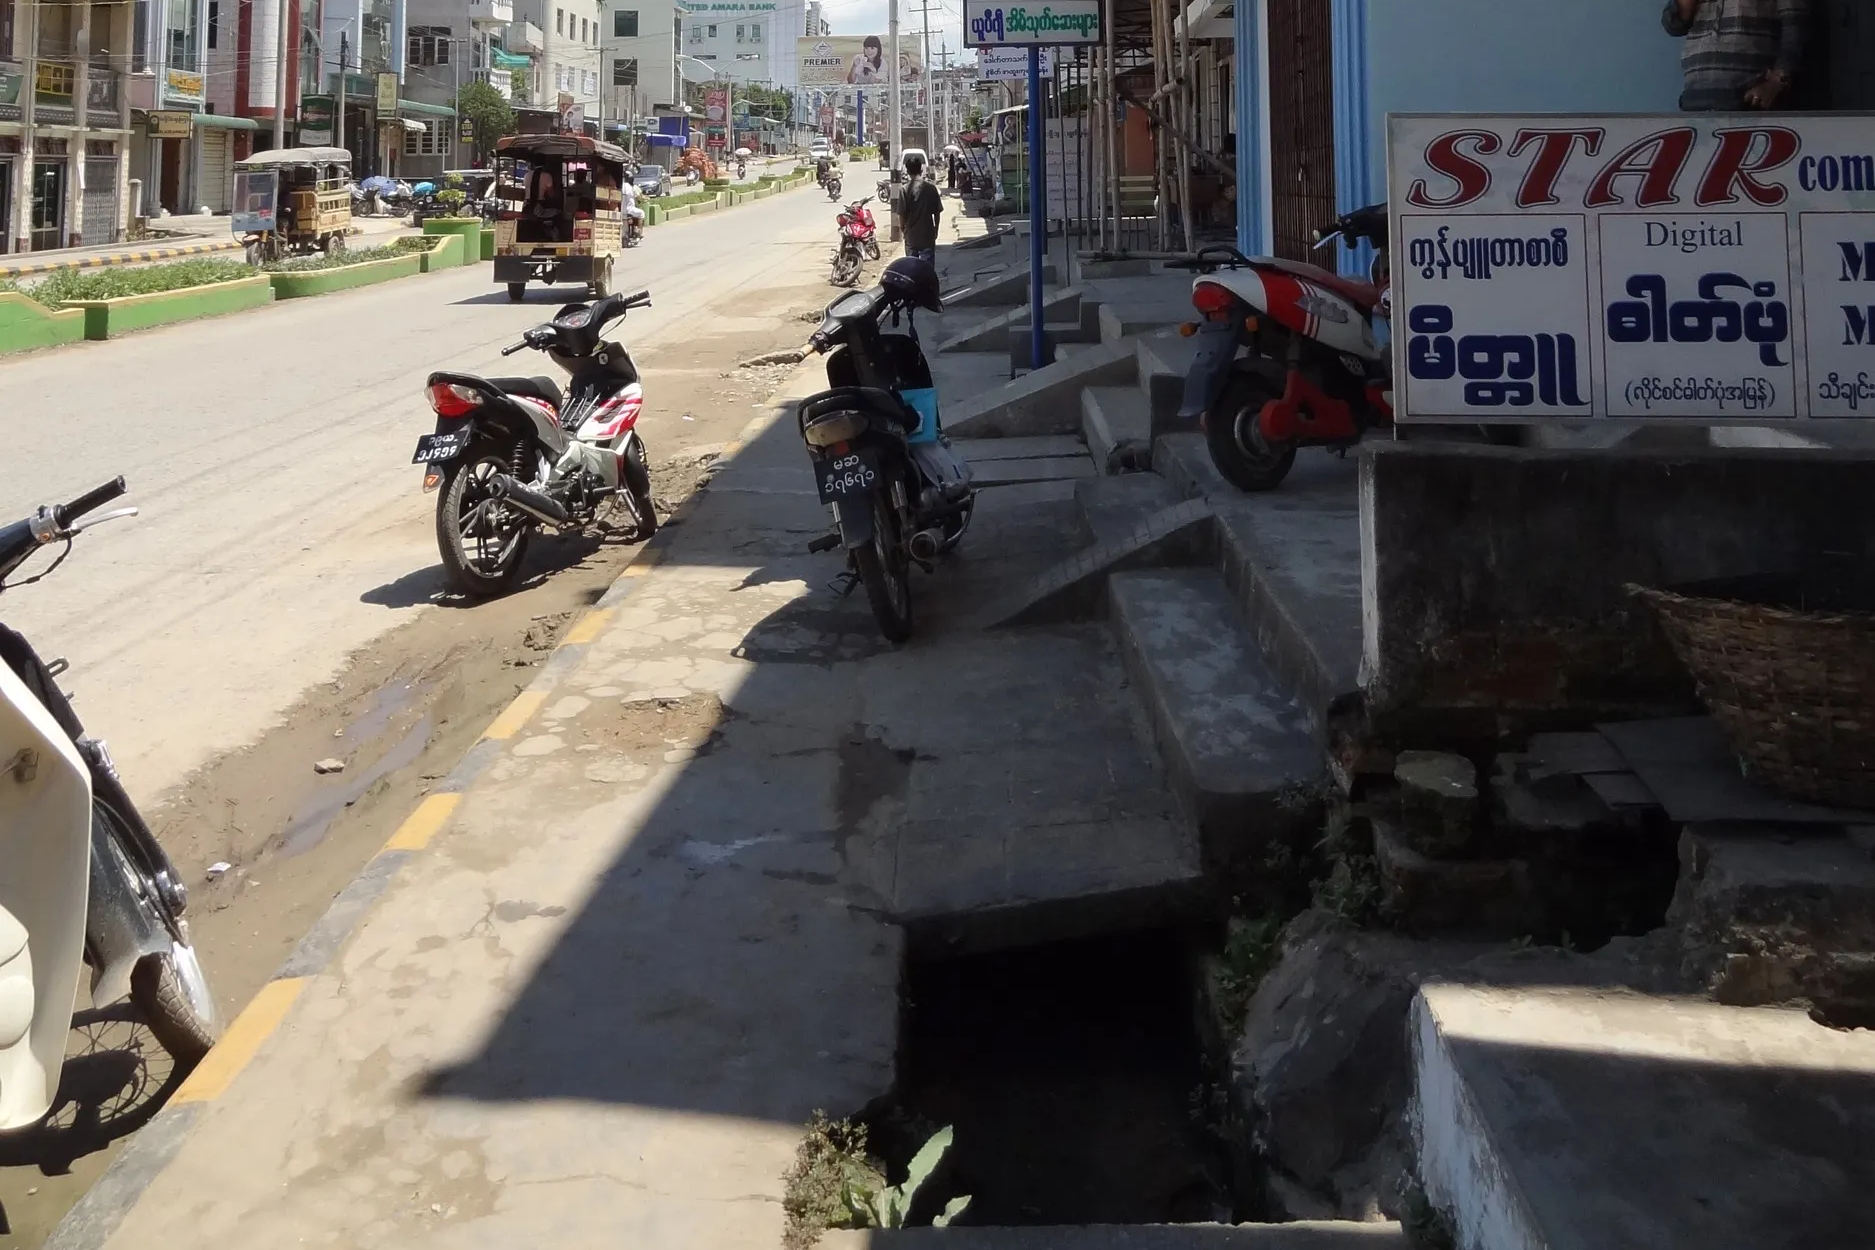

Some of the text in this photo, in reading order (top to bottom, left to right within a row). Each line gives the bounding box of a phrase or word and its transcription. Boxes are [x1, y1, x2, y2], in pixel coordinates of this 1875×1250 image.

[711, 3, 746, 11] AMARA
[749, 3, 776, 11] BANK
[803, 57, 841, 66] PREMIER
[1405, 126, 1801, 209] STAR
[1644, 220, 1744, 254] Digital
